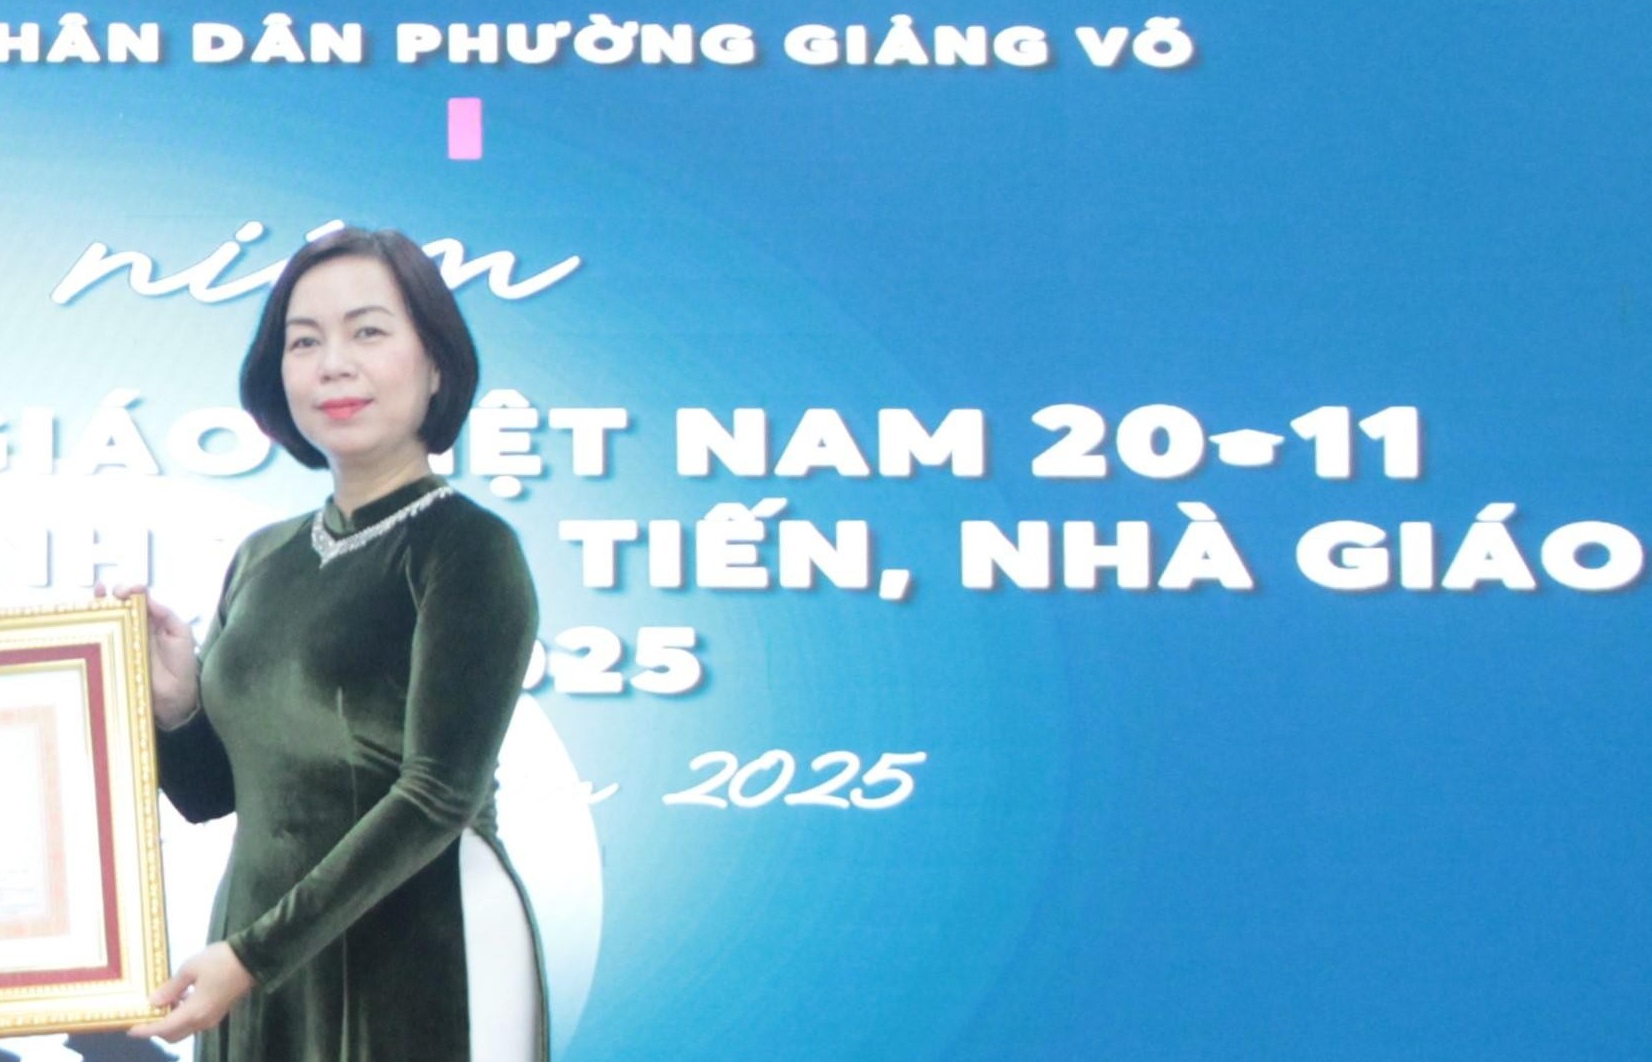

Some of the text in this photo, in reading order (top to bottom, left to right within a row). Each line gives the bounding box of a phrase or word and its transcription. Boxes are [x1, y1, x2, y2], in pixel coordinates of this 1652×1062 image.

[192, 13, 362, 63] DÂN
[397, 14, 754, 64] PHƯỜNG
[784, 14, 1048, 66] GIẢNG
[1076, 17, 1193, 67] VÕ
[51, 218, 581, 304] nim
[676, 408, 984, 476] NAM
[559, 498, 913, 601] TIẾN,
[961, 502, 1253, 589] NHÀ
[1297, 503, 1643, 590] GIÁO
[662, 749, 926, 809] 2025
